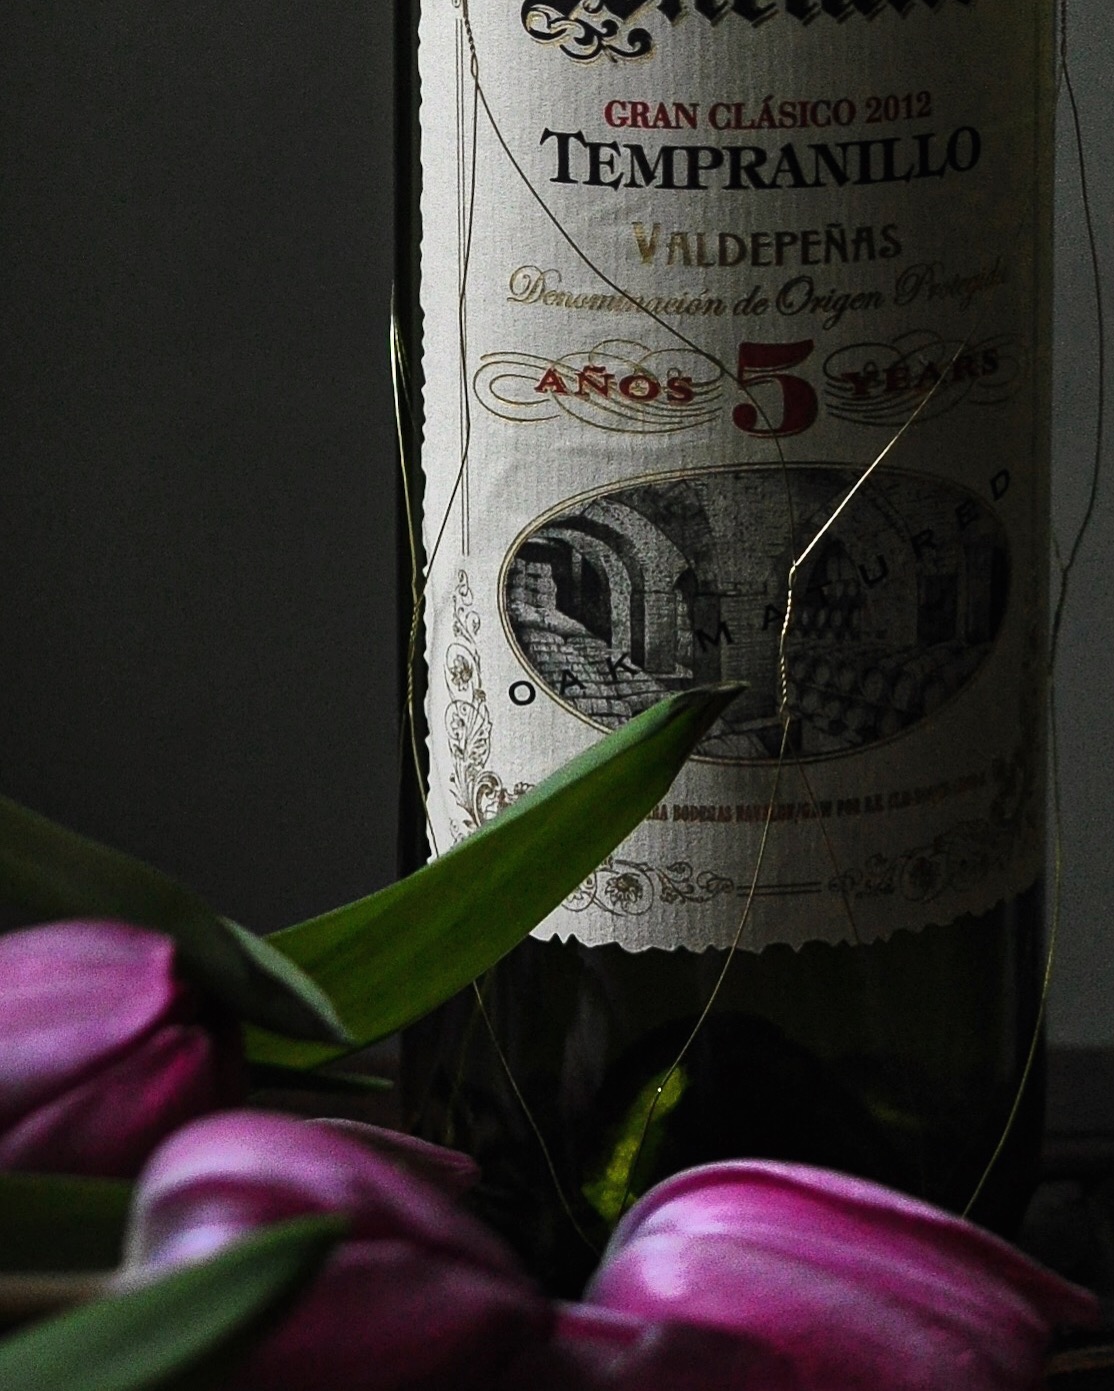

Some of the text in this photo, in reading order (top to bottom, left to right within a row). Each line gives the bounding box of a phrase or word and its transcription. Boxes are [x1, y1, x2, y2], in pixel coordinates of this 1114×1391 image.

[605, 90, 932, 130] GRAN CLÁSICO 2012
[540, 124, 982, 191] TEMPRANILLO
[632, 221, 901, 268] VALDEPEÑAS
[733, 284, 769, 317] de
[775, 275, 884, 330] Origen
[534, 338, 999, 438] AÑOS 5 YEARS
[508, 652, 638, 707] OAK
